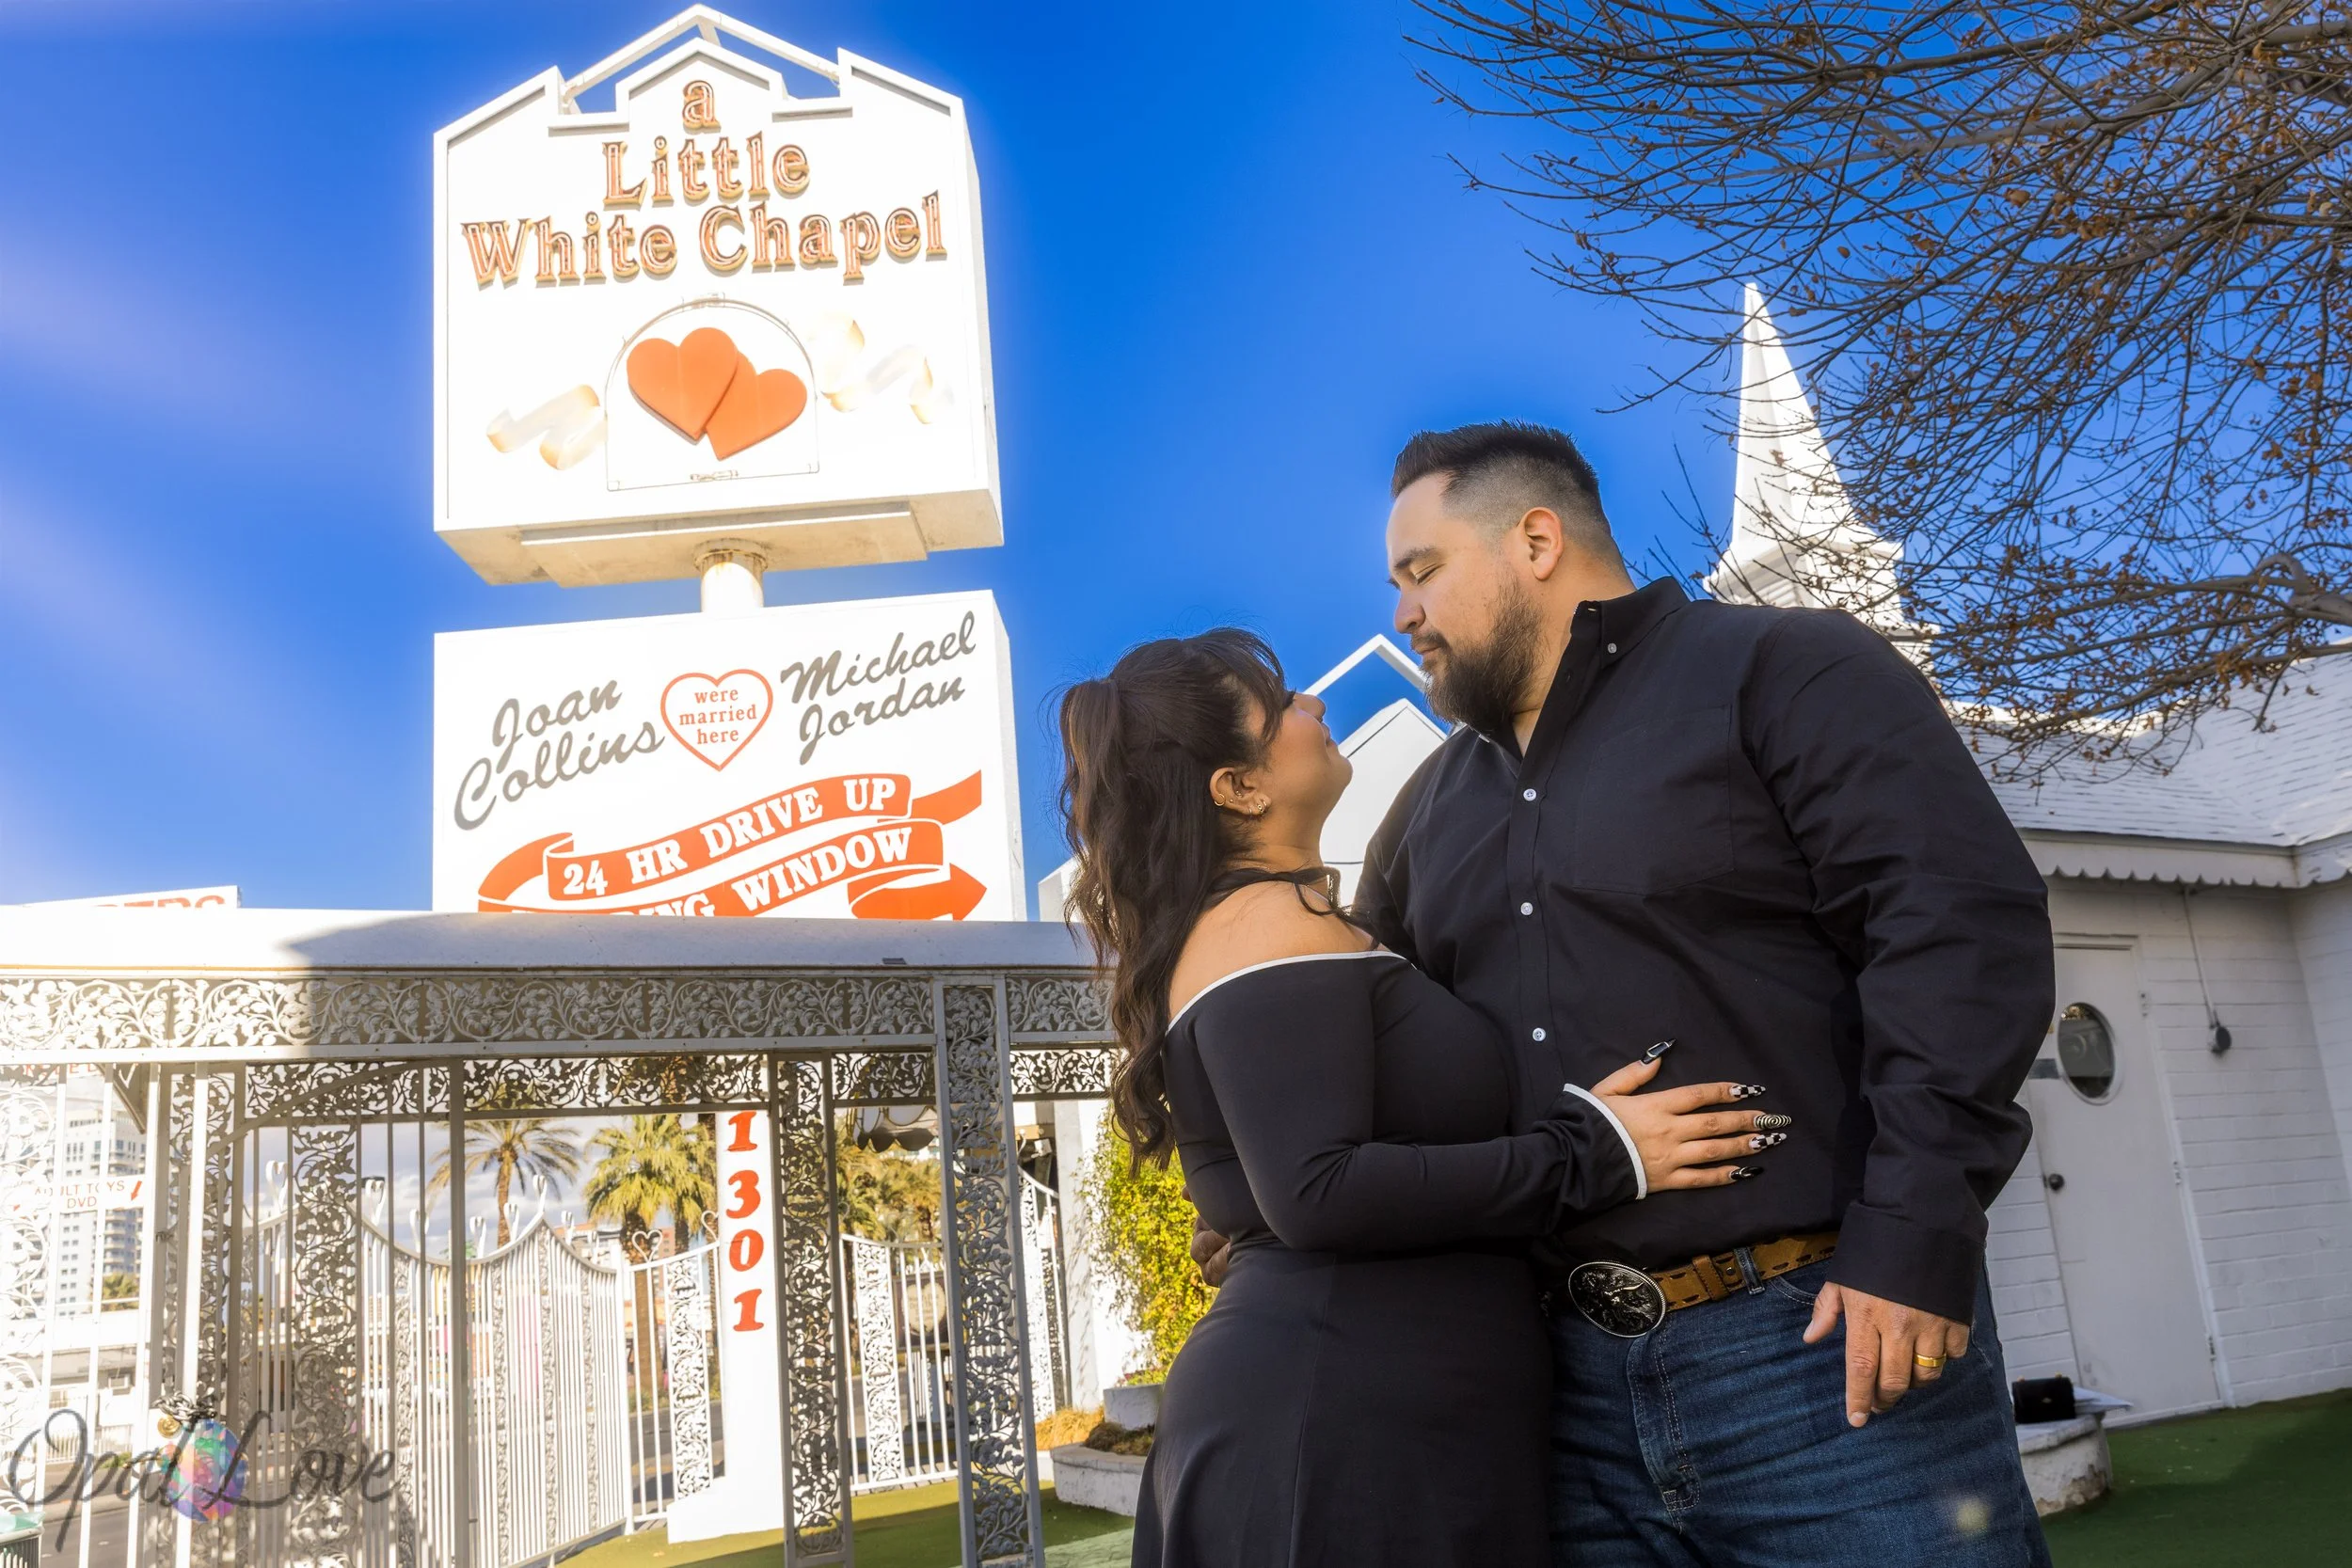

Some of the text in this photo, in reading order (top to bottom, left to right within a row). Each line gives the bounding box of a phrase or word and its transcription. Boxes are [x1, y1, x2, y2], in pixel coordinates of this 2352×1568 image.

[682, 80, 721, 129] a
[602, 131, 810, 207] Little
[461, 190, 947, 286] White Chapel
[694, 689, 739, 704] were
[780, 610, 977, 705] Michael
[492, 679, 623, 774] Joan
[679, 705, 757, 725] married
[697, 729, 739, 745] here
[800, 676, 966, 766] Jordan
[453, 721, 665, 831] Collins
[564, 779, 897, 895] 24 HR DRIVE UP
[731, 827, 913, 912] WINDOW
[725, 1110, 764, 1332] 1301
